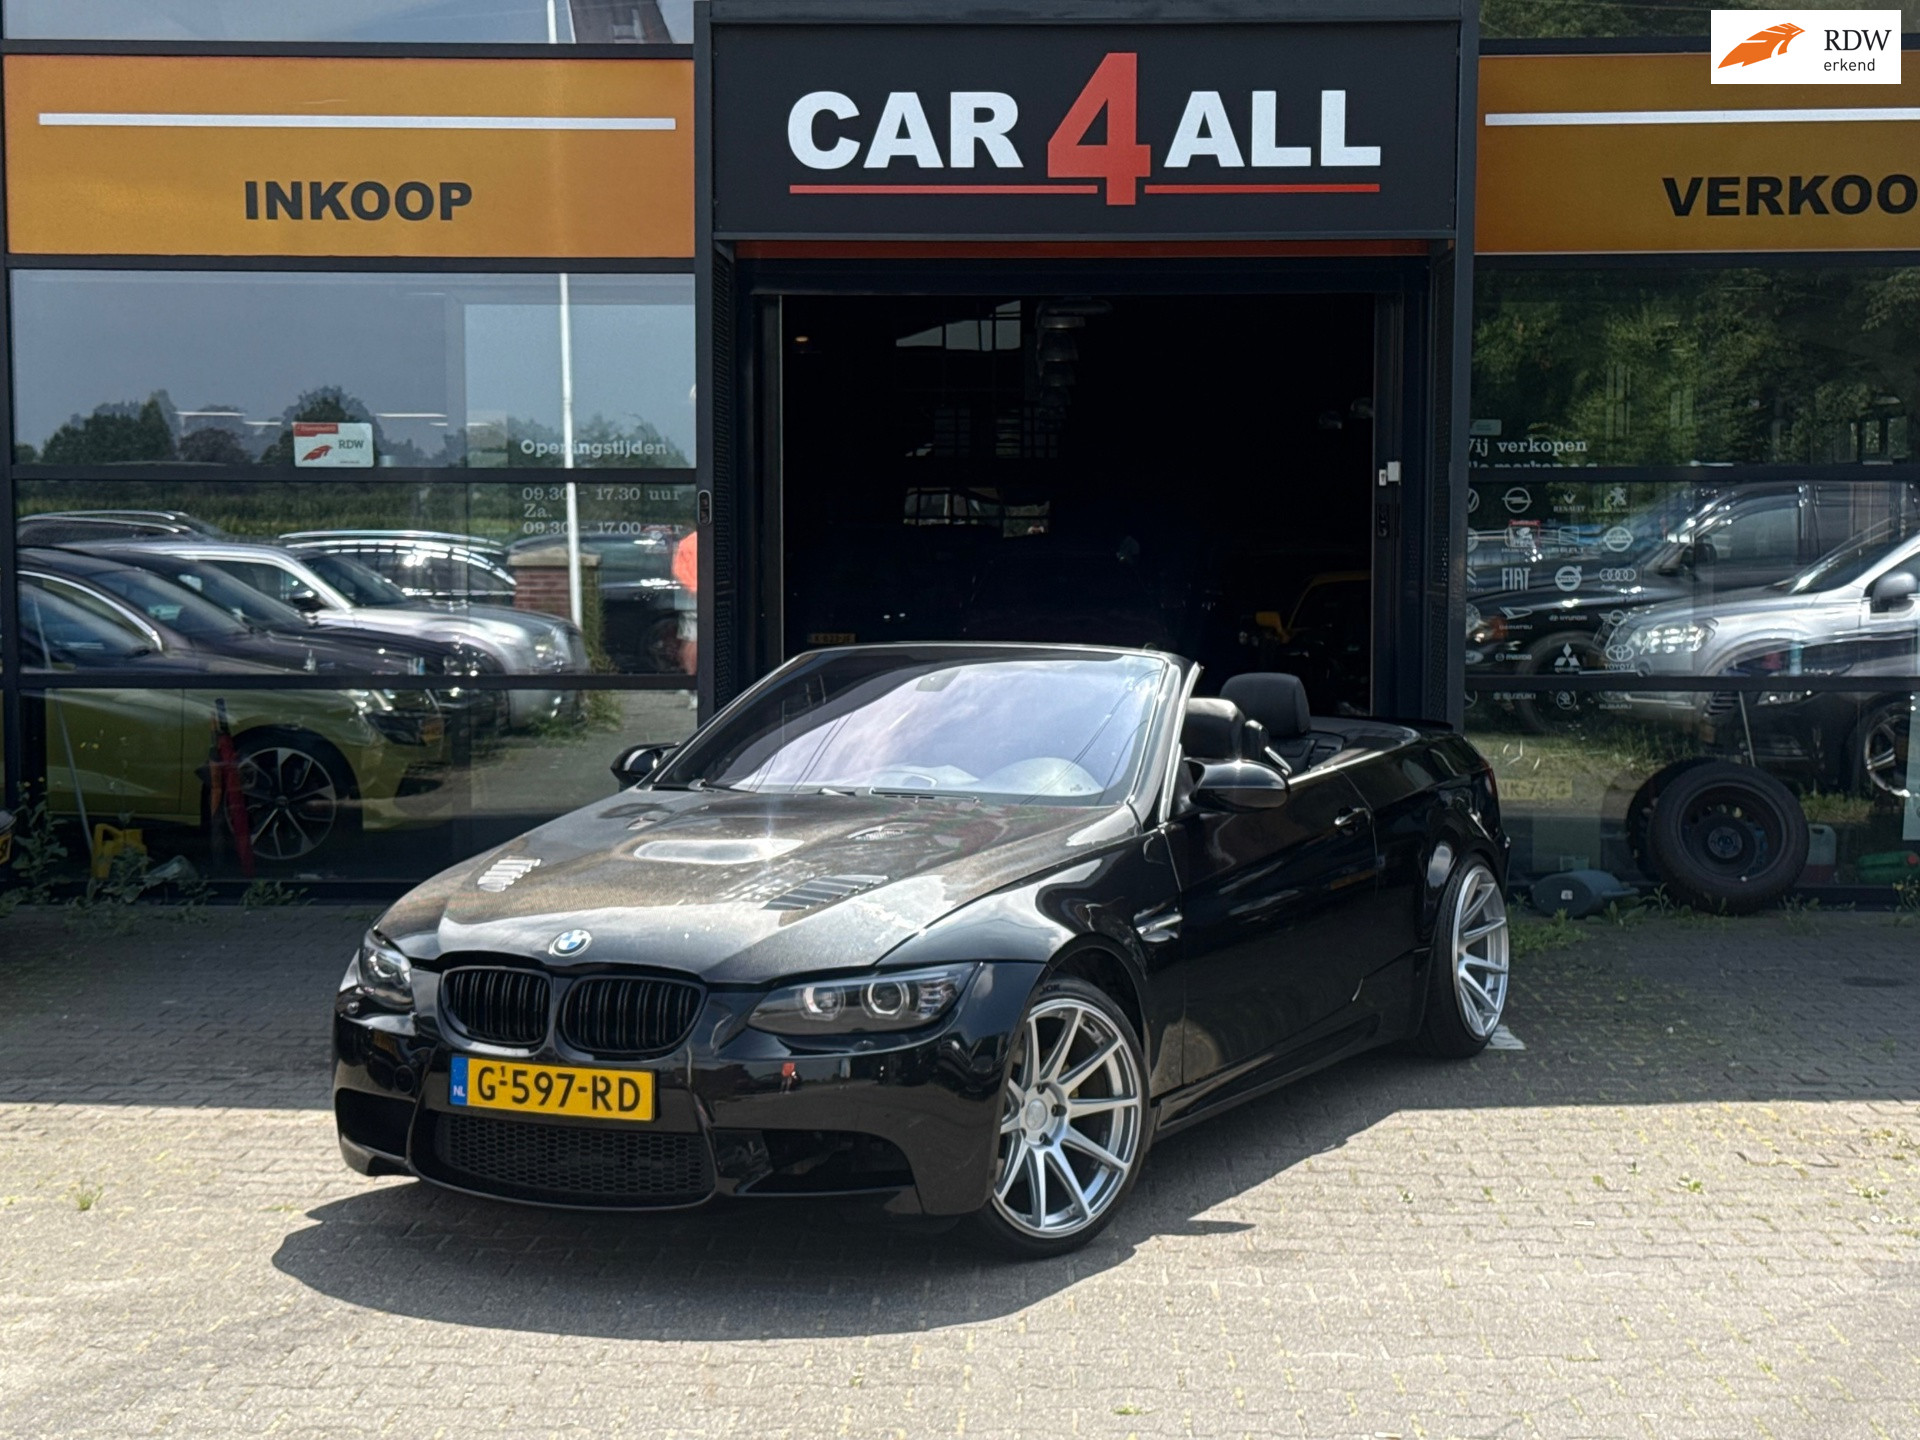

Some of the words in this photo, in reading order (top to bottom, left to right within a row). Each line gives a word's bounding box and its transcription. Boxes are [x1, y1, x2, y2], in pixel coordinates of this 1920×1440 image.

[787, 90, 1024, 170] CAR
[1047, 53, 1151, 206] 4
[1163, 89, 1382, 168] ALL
[245, 181, 472, 221] INKOOP
[339, 440, 364, 449] RDW
[1496, 438, 1588, 456] verkopen
[596, 487, 640, 501] 17.30
[649, 489, 682, 501] uur
[524, 503, 552, 518] Za.
[1553, 505, 1585, 513] RENAULT
[597, 521, 641, 535] 17.00
[1502, 567, 1531, 591] FIAT
[1604, 663, 1635, 671] TOYOTA
[453, 1085, 466, 1097] NL
[477, 1066, 641, 1113] G-597-RD
